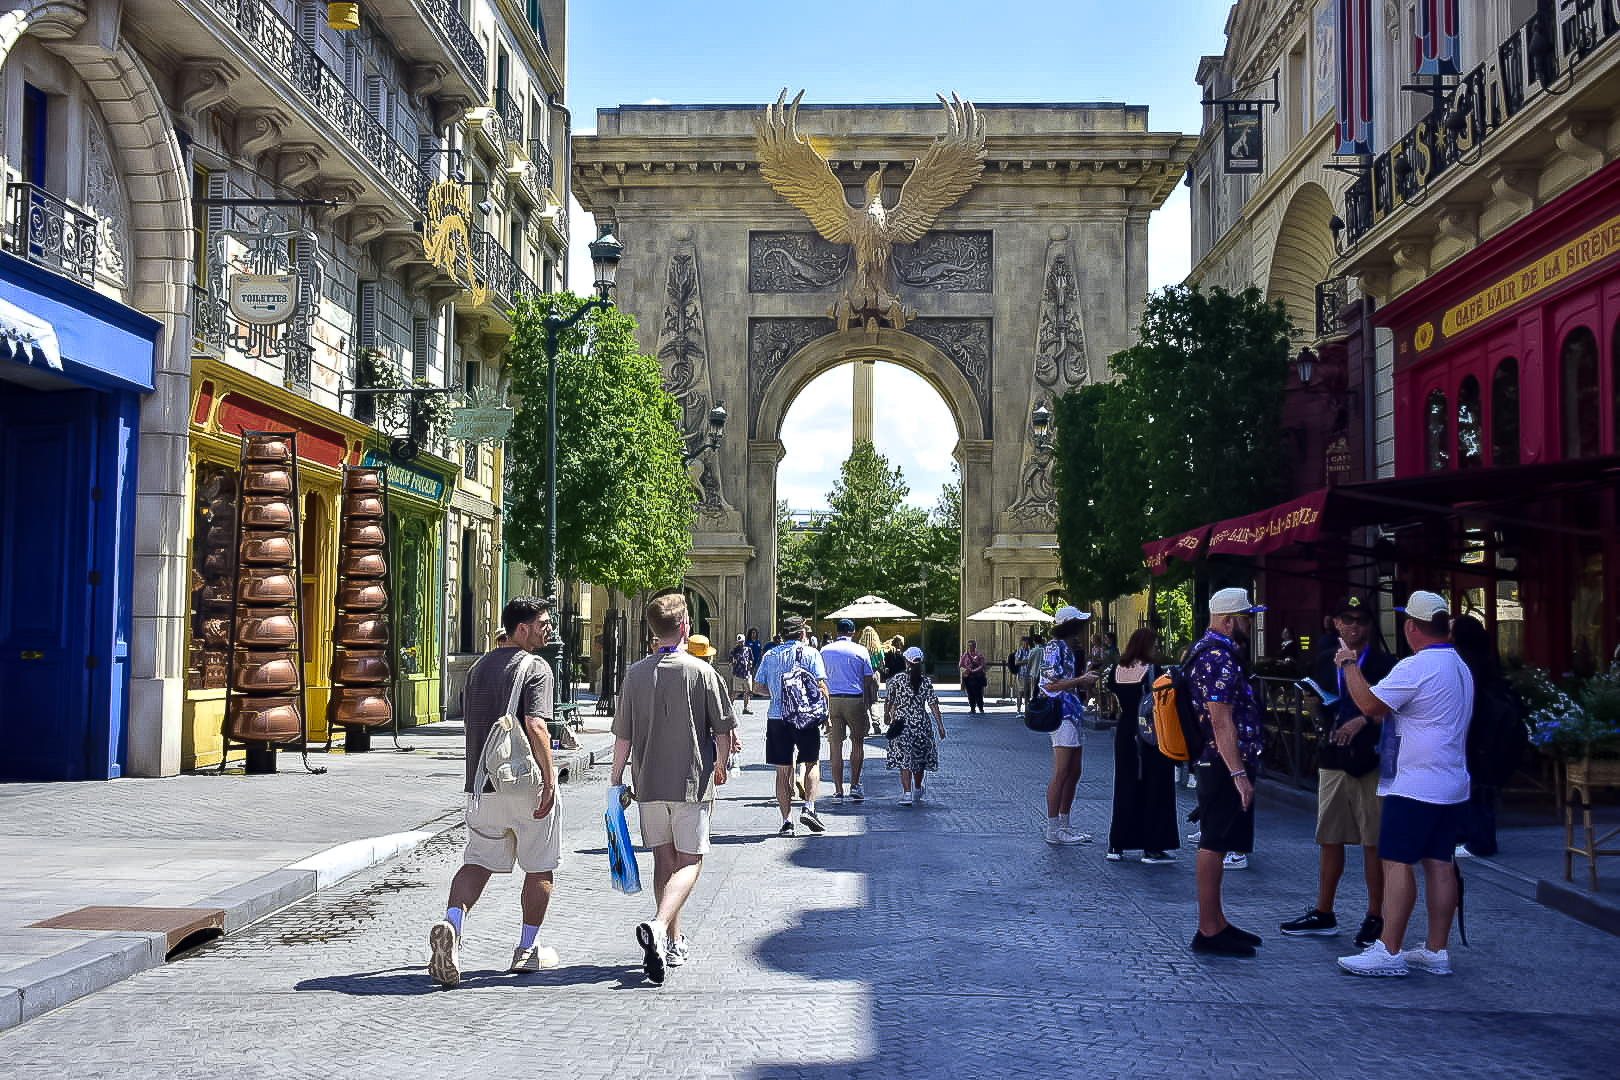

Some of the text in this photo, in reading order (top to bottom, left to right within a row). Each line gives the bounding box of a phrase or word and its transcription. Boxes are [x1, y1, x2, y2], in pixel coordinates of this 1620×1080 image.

[1520, 267, 1538, 292] DE
[1543, 255, 1561, 282] LA
[241, 294, 288, 303] TOILETTES
